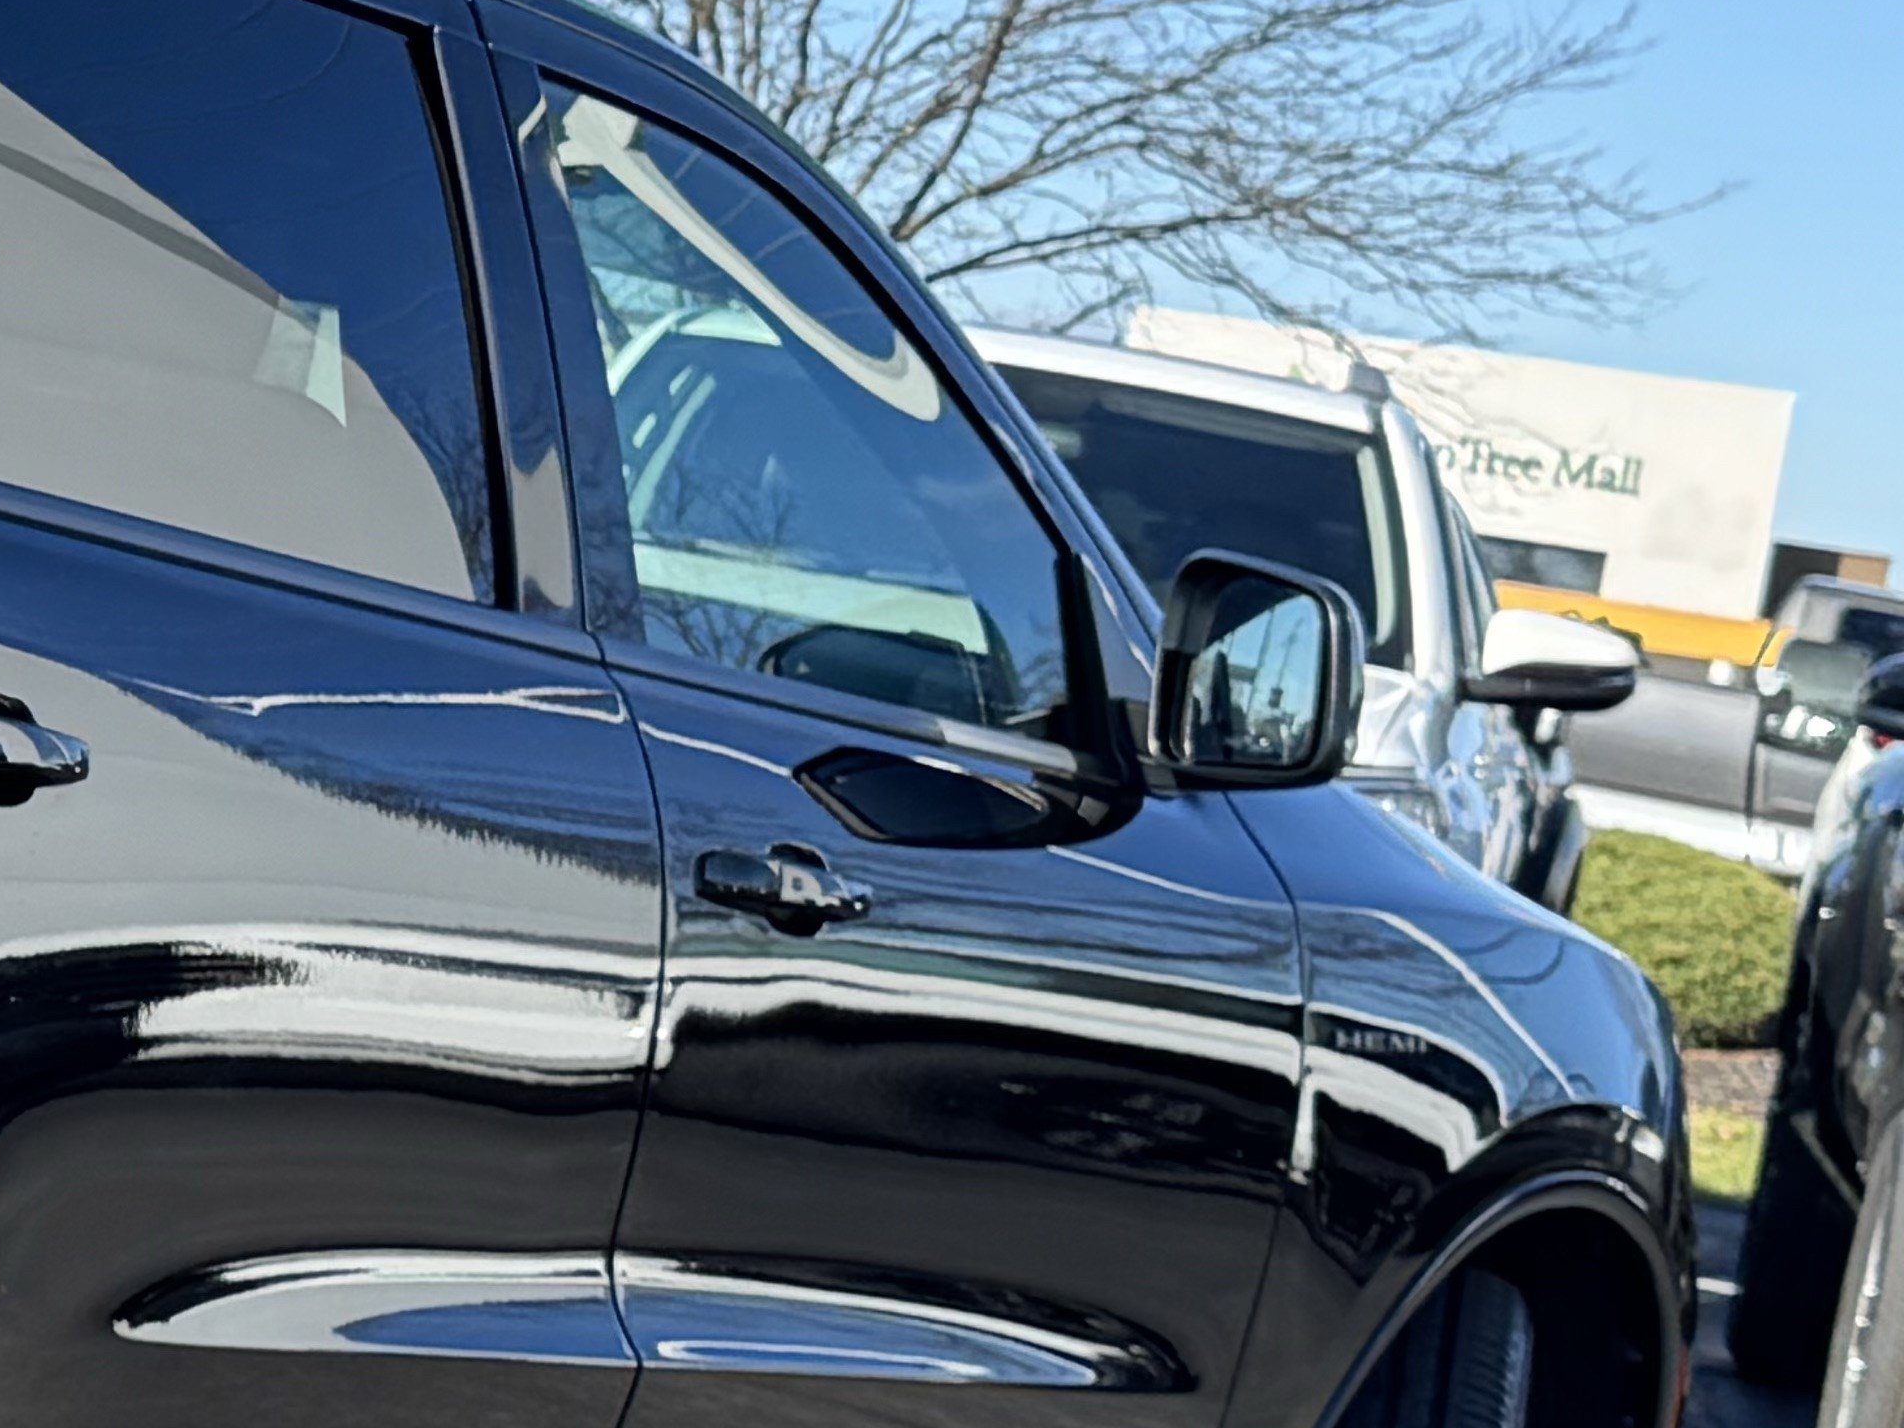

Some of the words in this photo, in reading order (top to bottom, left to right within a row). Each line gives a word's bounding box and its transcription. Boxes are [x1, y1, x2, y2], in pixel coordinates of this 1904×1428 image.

[1460, 435, 1544, 484] Tree
[1553, 448, 1645, 496] Mall
[1333, 1029, 1428, 1055] HEMI
